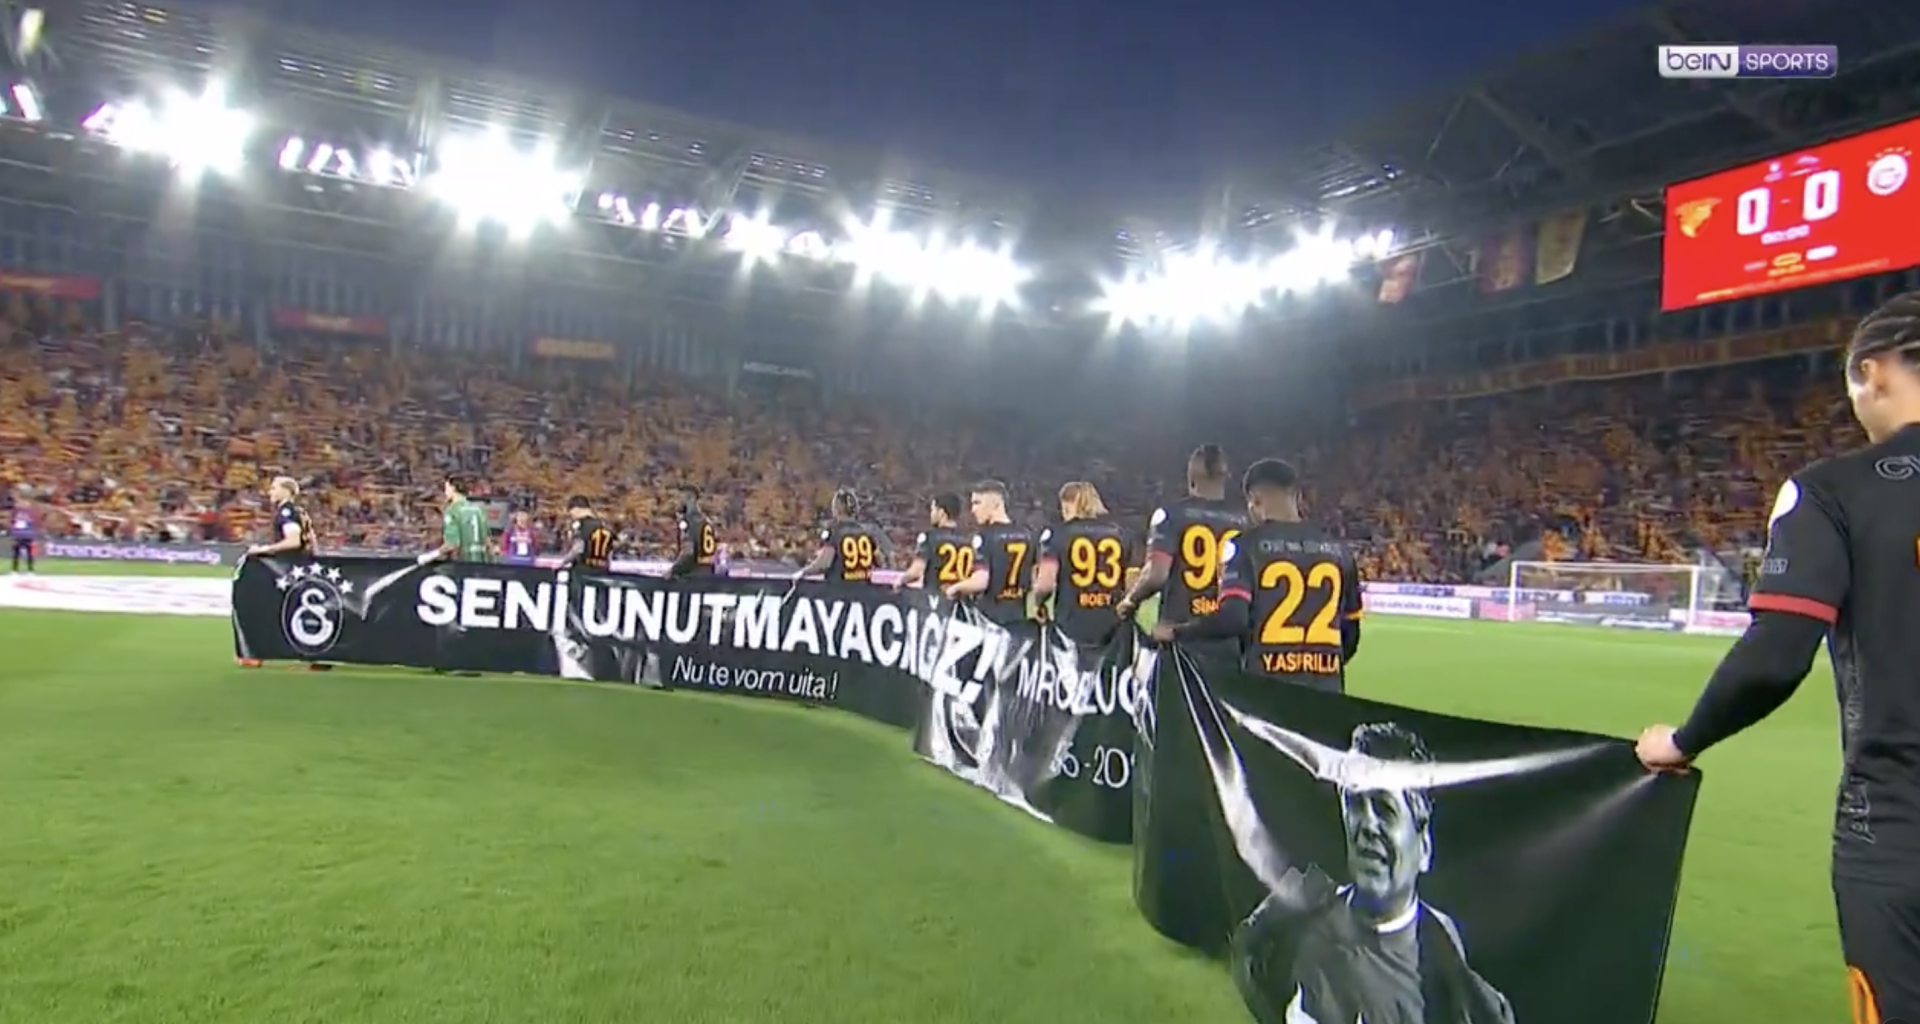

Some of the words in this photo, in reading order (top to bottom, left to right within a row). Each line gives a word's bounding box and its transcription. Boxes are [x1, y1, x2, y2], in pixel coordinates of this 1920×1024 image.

[1737, 186, 1769, 235] 0
[1803, 169, 1840, 221] 0
[469, 514, 479, 547] 1
[590, 528, 611, 558] 17
[702, 524, 715, 555] 6
[842, 534, 873, 569] 99
[938, 542, 974, 582] 20
[1006, 541, 1028, 586] 7
[1070, 536, 1122, 588] 93
[416, 569, 570, 633] SENİ
[1260, 560, 1342, 646] 22
[671, 654, 702, 684] Nu
[708, 661, 728, 687] te
[734, 667, 784, 692] vom
